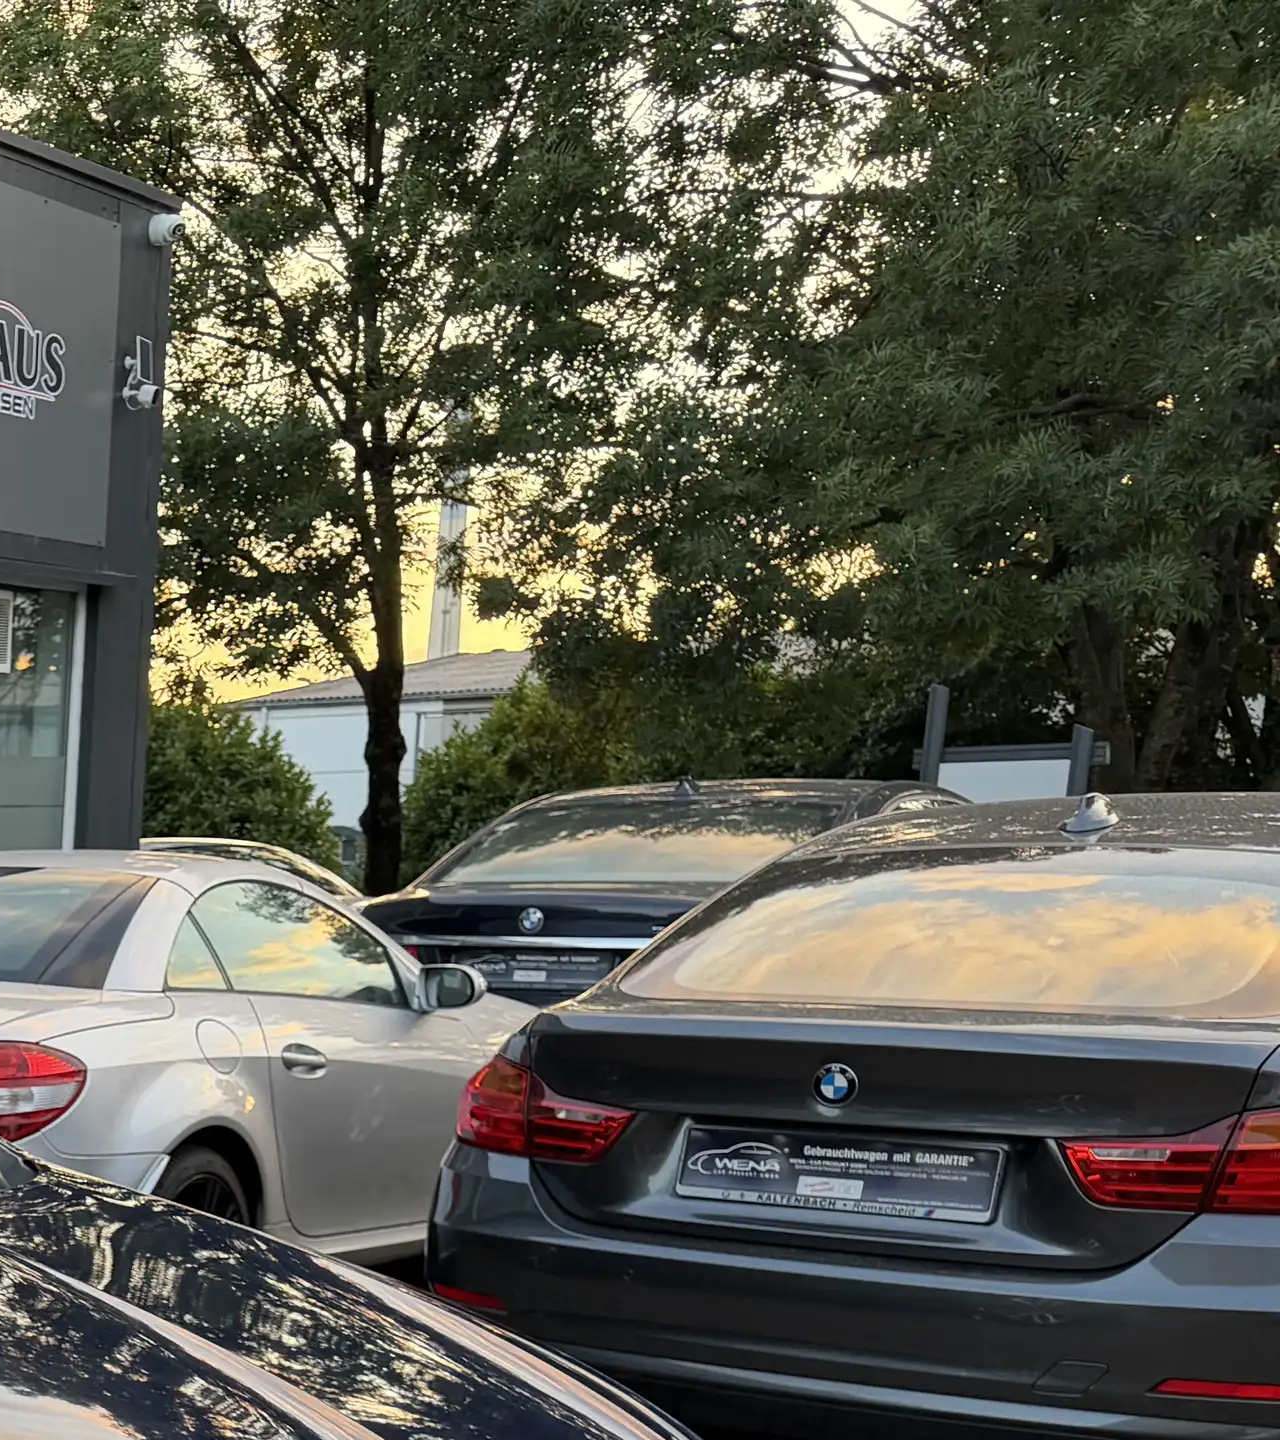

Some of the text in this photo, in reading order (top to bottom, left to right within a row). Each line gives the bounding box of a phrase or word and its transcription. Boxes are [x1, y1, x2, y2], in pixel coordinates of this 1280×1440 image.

[804, 1144, 888, 1162] Gebrauchtwagen
[893, 1151, 911, 1163] mit
[714, 1157, 781, 1173] WENA
